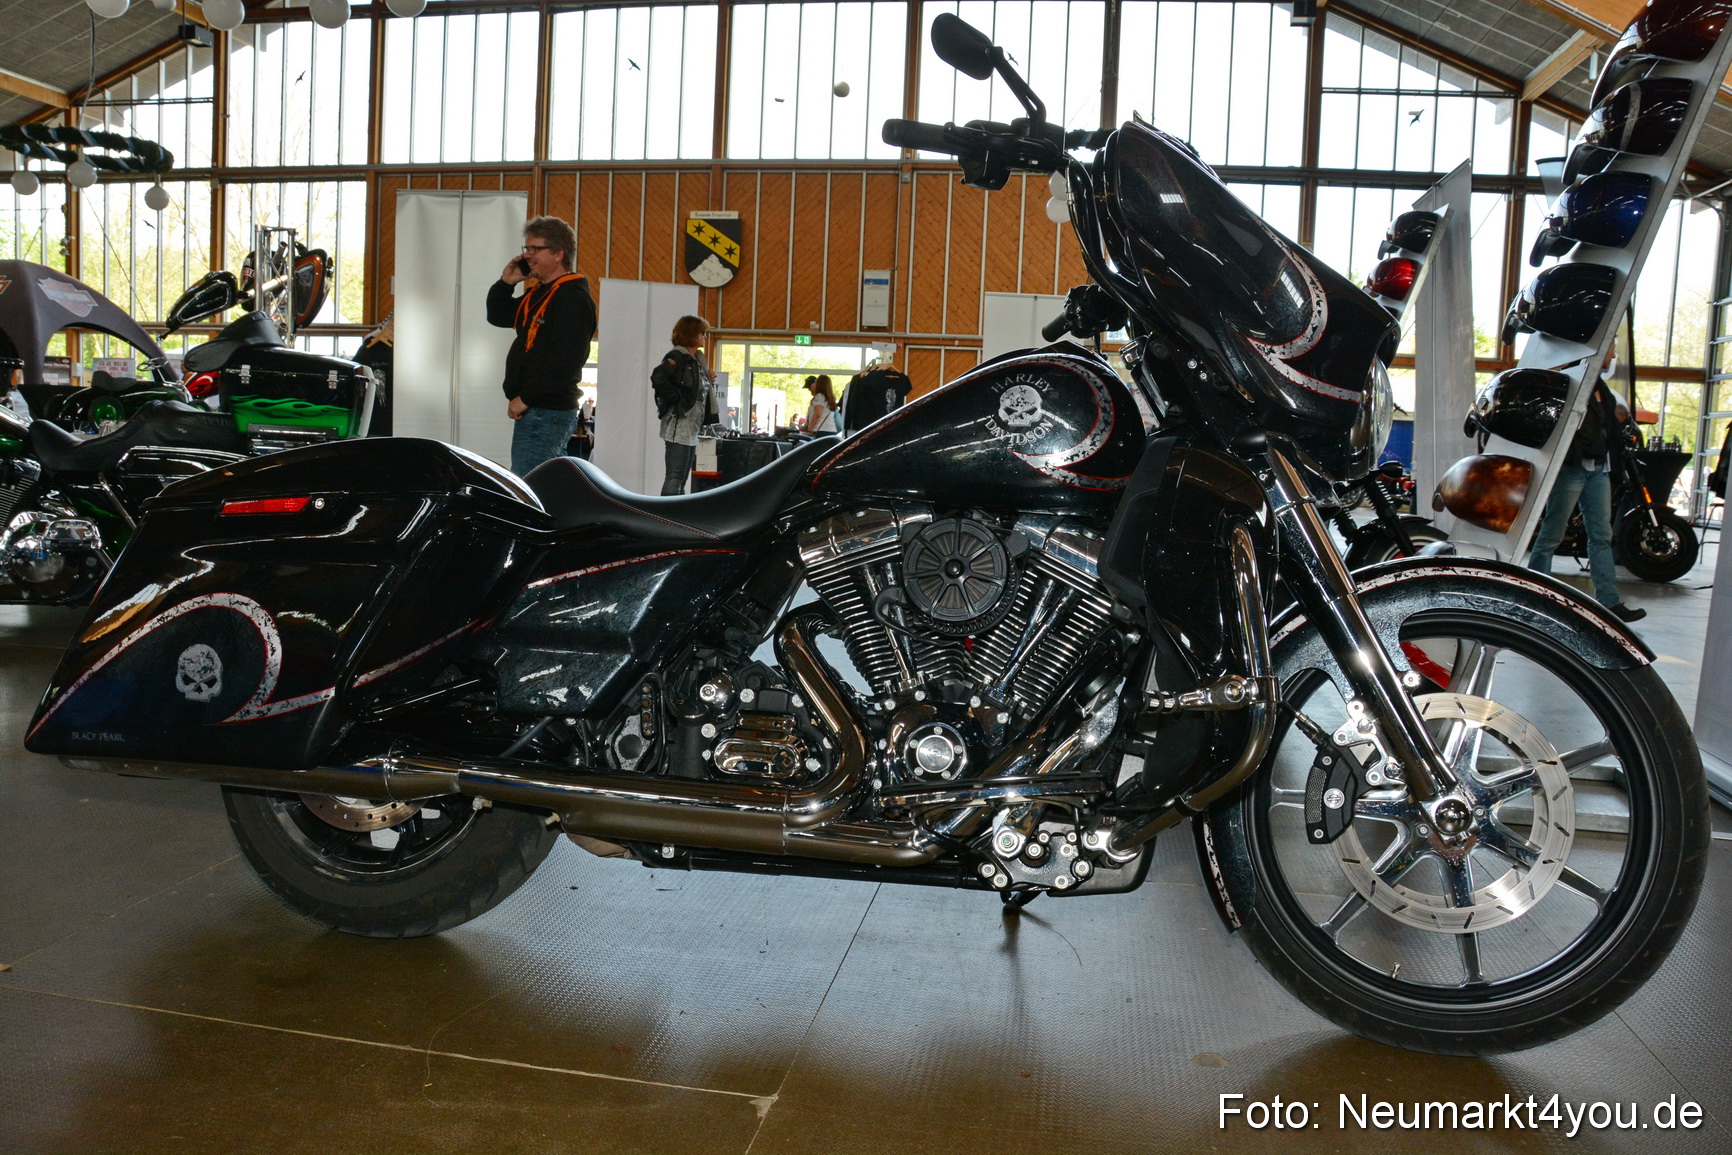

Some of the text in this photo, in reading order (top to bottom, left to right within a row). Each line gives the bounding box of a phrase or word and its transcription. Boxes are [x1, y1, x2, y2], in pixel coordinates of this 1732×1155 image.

[991, 374, 1055, 393] HARLEY
[985, 417, 1054, 446] DAVIDSON
[71, 731, 125, 742] BLACK PEARL
